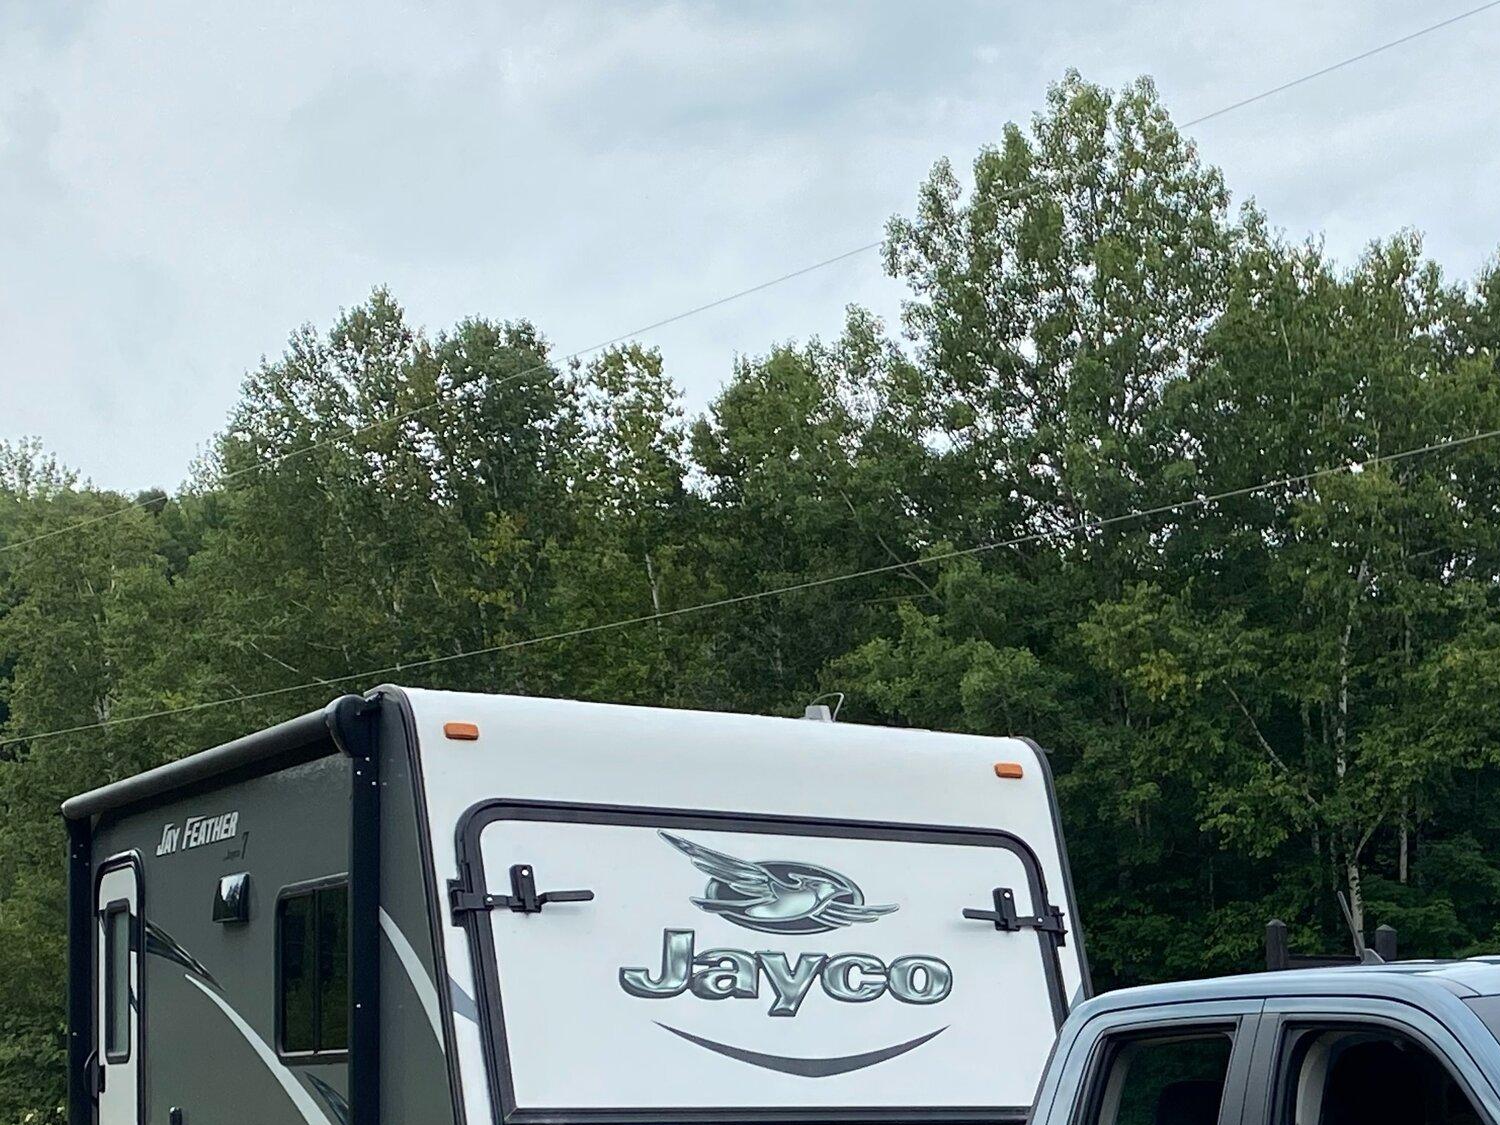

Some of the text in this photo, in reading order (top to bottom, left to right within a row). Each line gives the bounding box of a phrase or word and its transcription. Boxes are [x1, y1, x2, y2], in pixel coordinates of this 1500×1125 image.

[156, 811, 239, 856] JAY FEATHER
[618, 928, 953, 1017] Jayco
